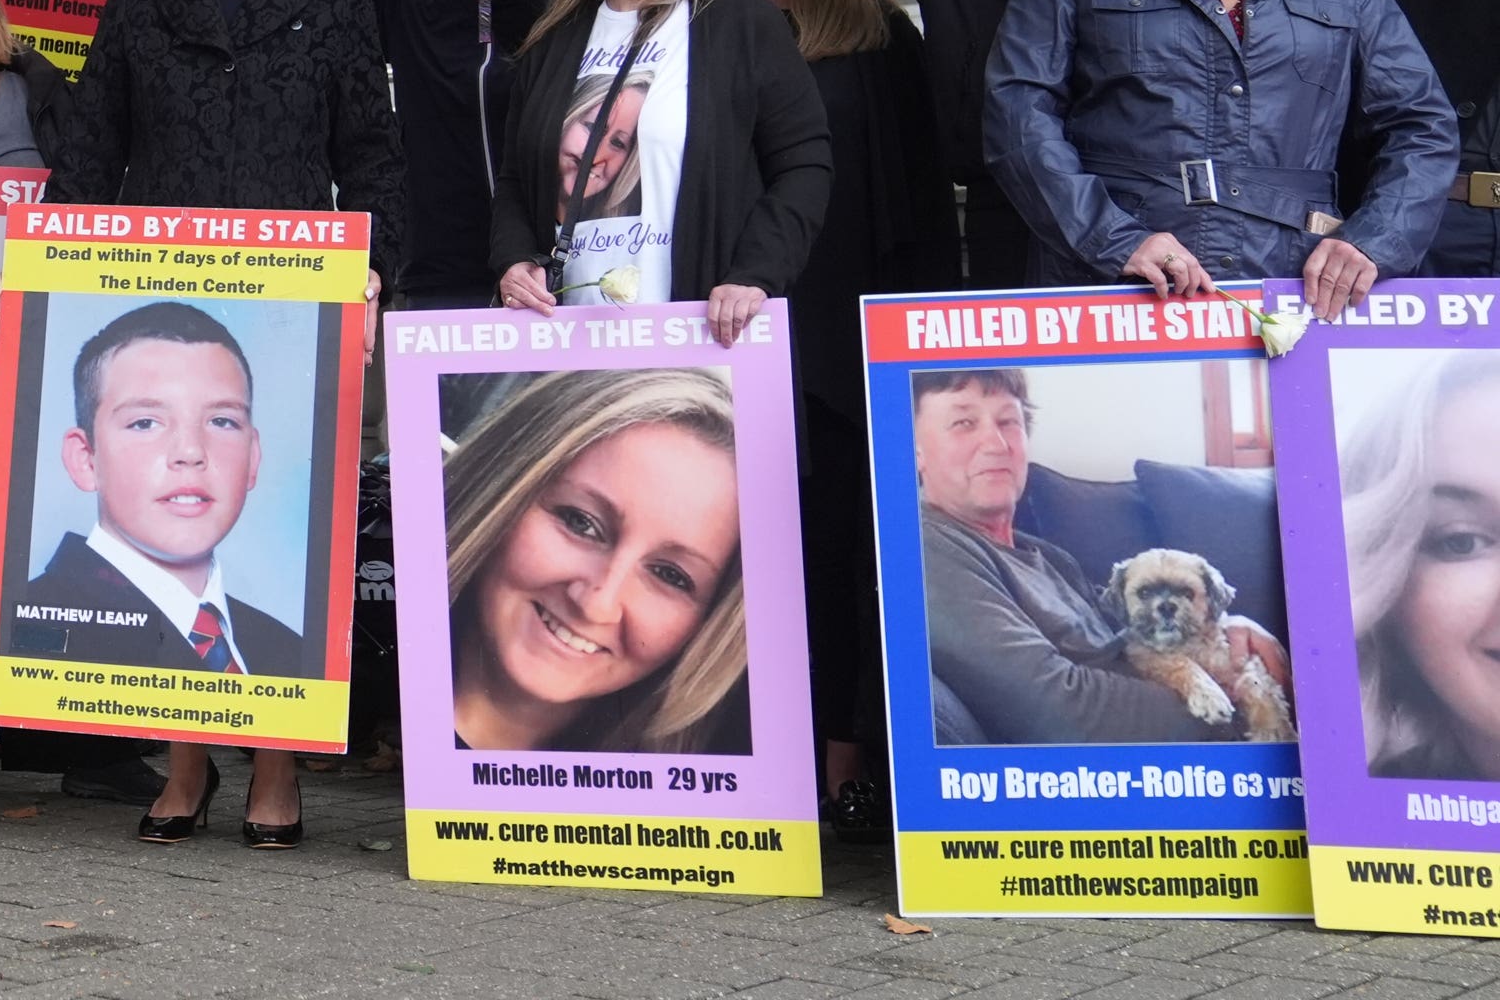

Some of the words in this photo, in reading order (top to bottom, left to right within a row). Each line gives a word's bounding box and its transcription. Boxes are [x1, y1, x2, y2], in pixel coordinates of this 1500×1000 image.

[27, 213, 131, 236] FAILED
[144, 217, 181, 237] BY
[193, 218, 245, 239] THE
[258, 220, 345, 242] STATE
[588, 227, 626, 253] Love
[628, 222, 671, 255] You
[46, 246, 91, 260] Dead
[97, 248, 151, 262] within
[158, 250, 168, 263] 7
[174, 251, 215, 267] days
[222, 252, 240, 265] of
[246, 254, 324, 271] entering
[100, 275, 130, 289] The
[137, 277, 197, 291] Linden
[203, 279, 264, 294] Center
[17, 605, 93, 622] MATTHEW
[97, 611, 147, 626] LEAHY
[473, 763, 567, 787] Michelle
[573, 766, 652, 789] Morton
[668, 767, 696, 790] 29
[701, 772, 737, 793] yrs
[941, 768, 997, 802] Roy
[1005, 766, 1226, 798] Breaker-Rolfe
[1233, 773, 1263, 797] 63
[1267, 774, 1304, 798] yrs
[1407, 794, 1500, 826] Abbiga
[493, 858, 734, 887] #matthewscampaign
